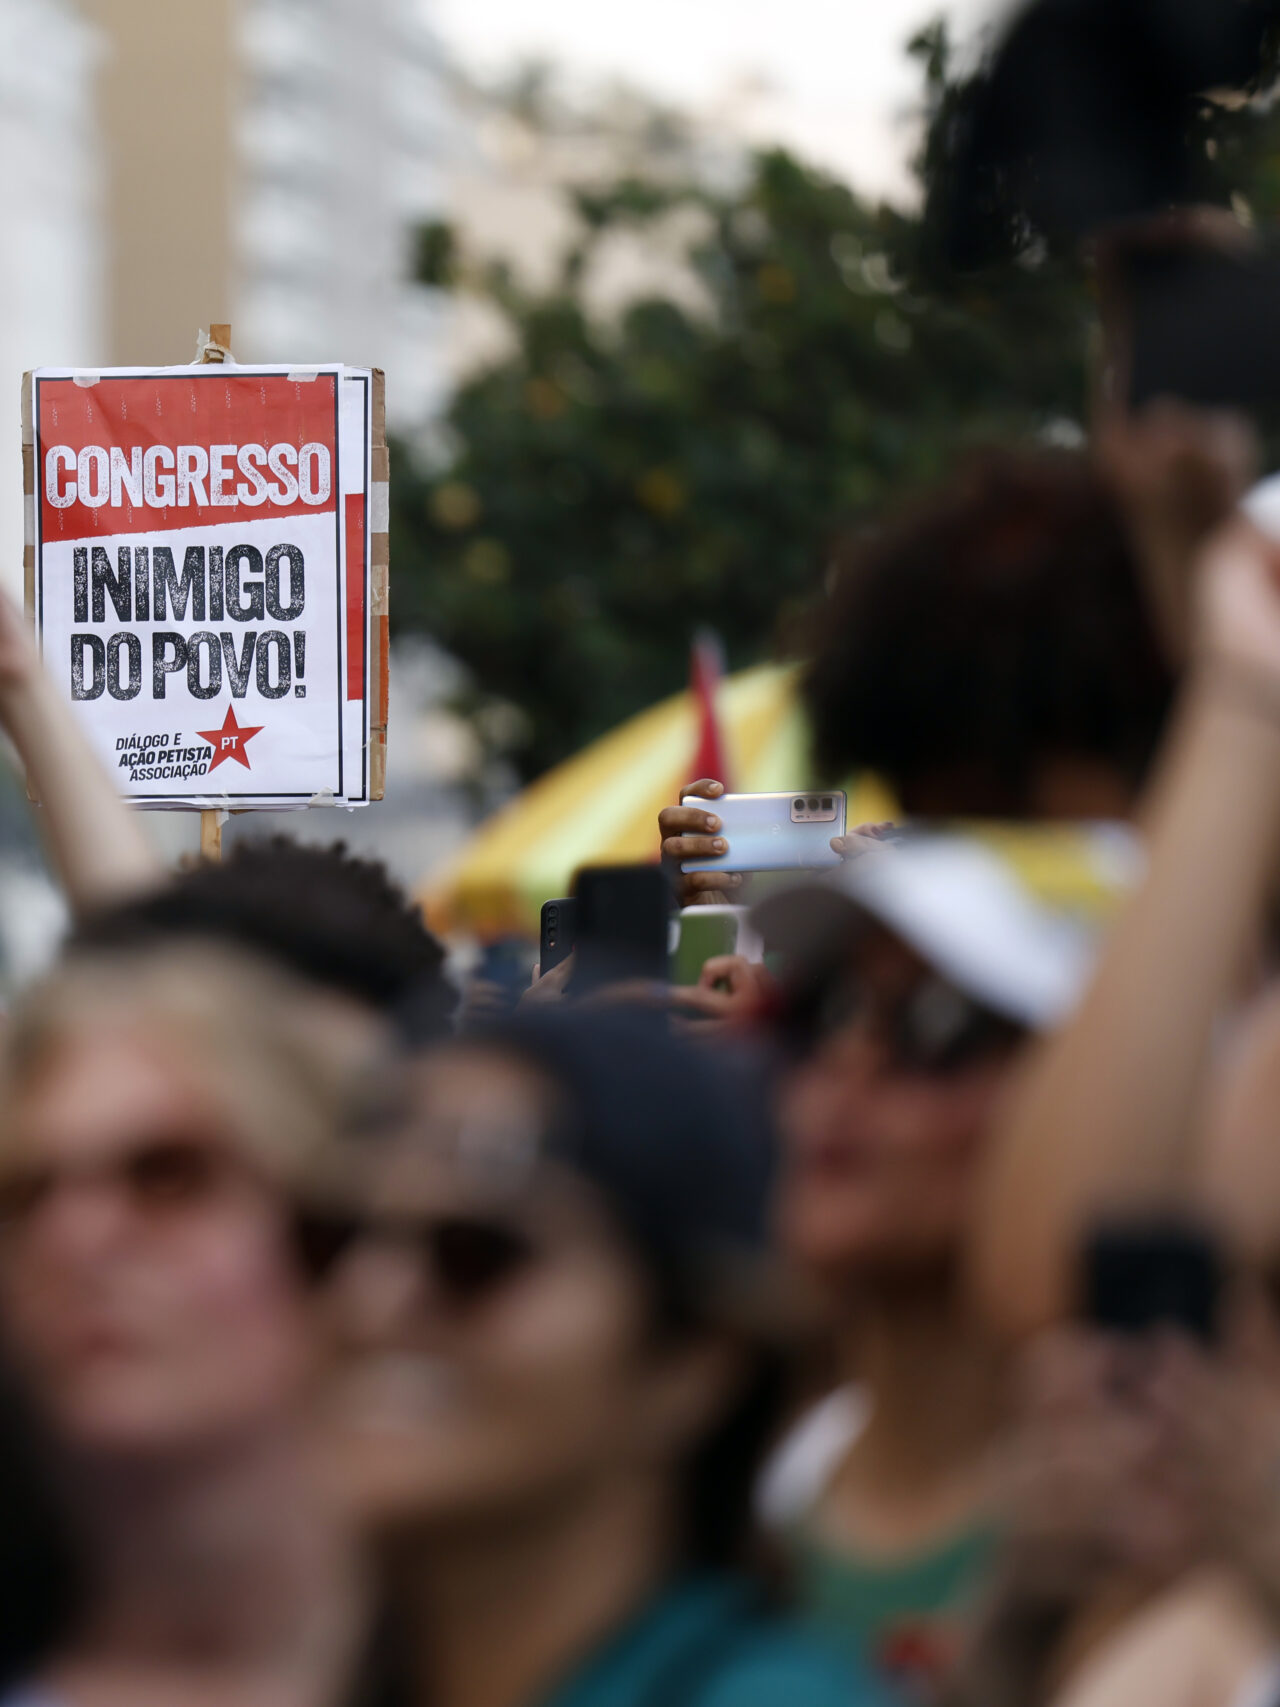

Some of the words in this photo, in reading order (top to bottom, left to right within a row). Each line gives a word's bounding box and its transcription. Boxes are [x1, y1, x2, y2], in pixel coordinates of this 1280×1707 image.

[45, 442, 331, 508] CONGRESSO
[73, 543, 305, 623] INIMIGO
[70, 632, 142, 701] DO
[152, 630, 307, 700] POVO!
[115, 733, 170, 751] DIÁLOGO
[173, 733, 182, 746] E
[221, 736, 239, 750] PT
[118, 748, 156, 769] AÇÃO
[157, 746, 212, 763] PETISTA
[129, 762, 208, 782] ASSOCIAÇÃO
